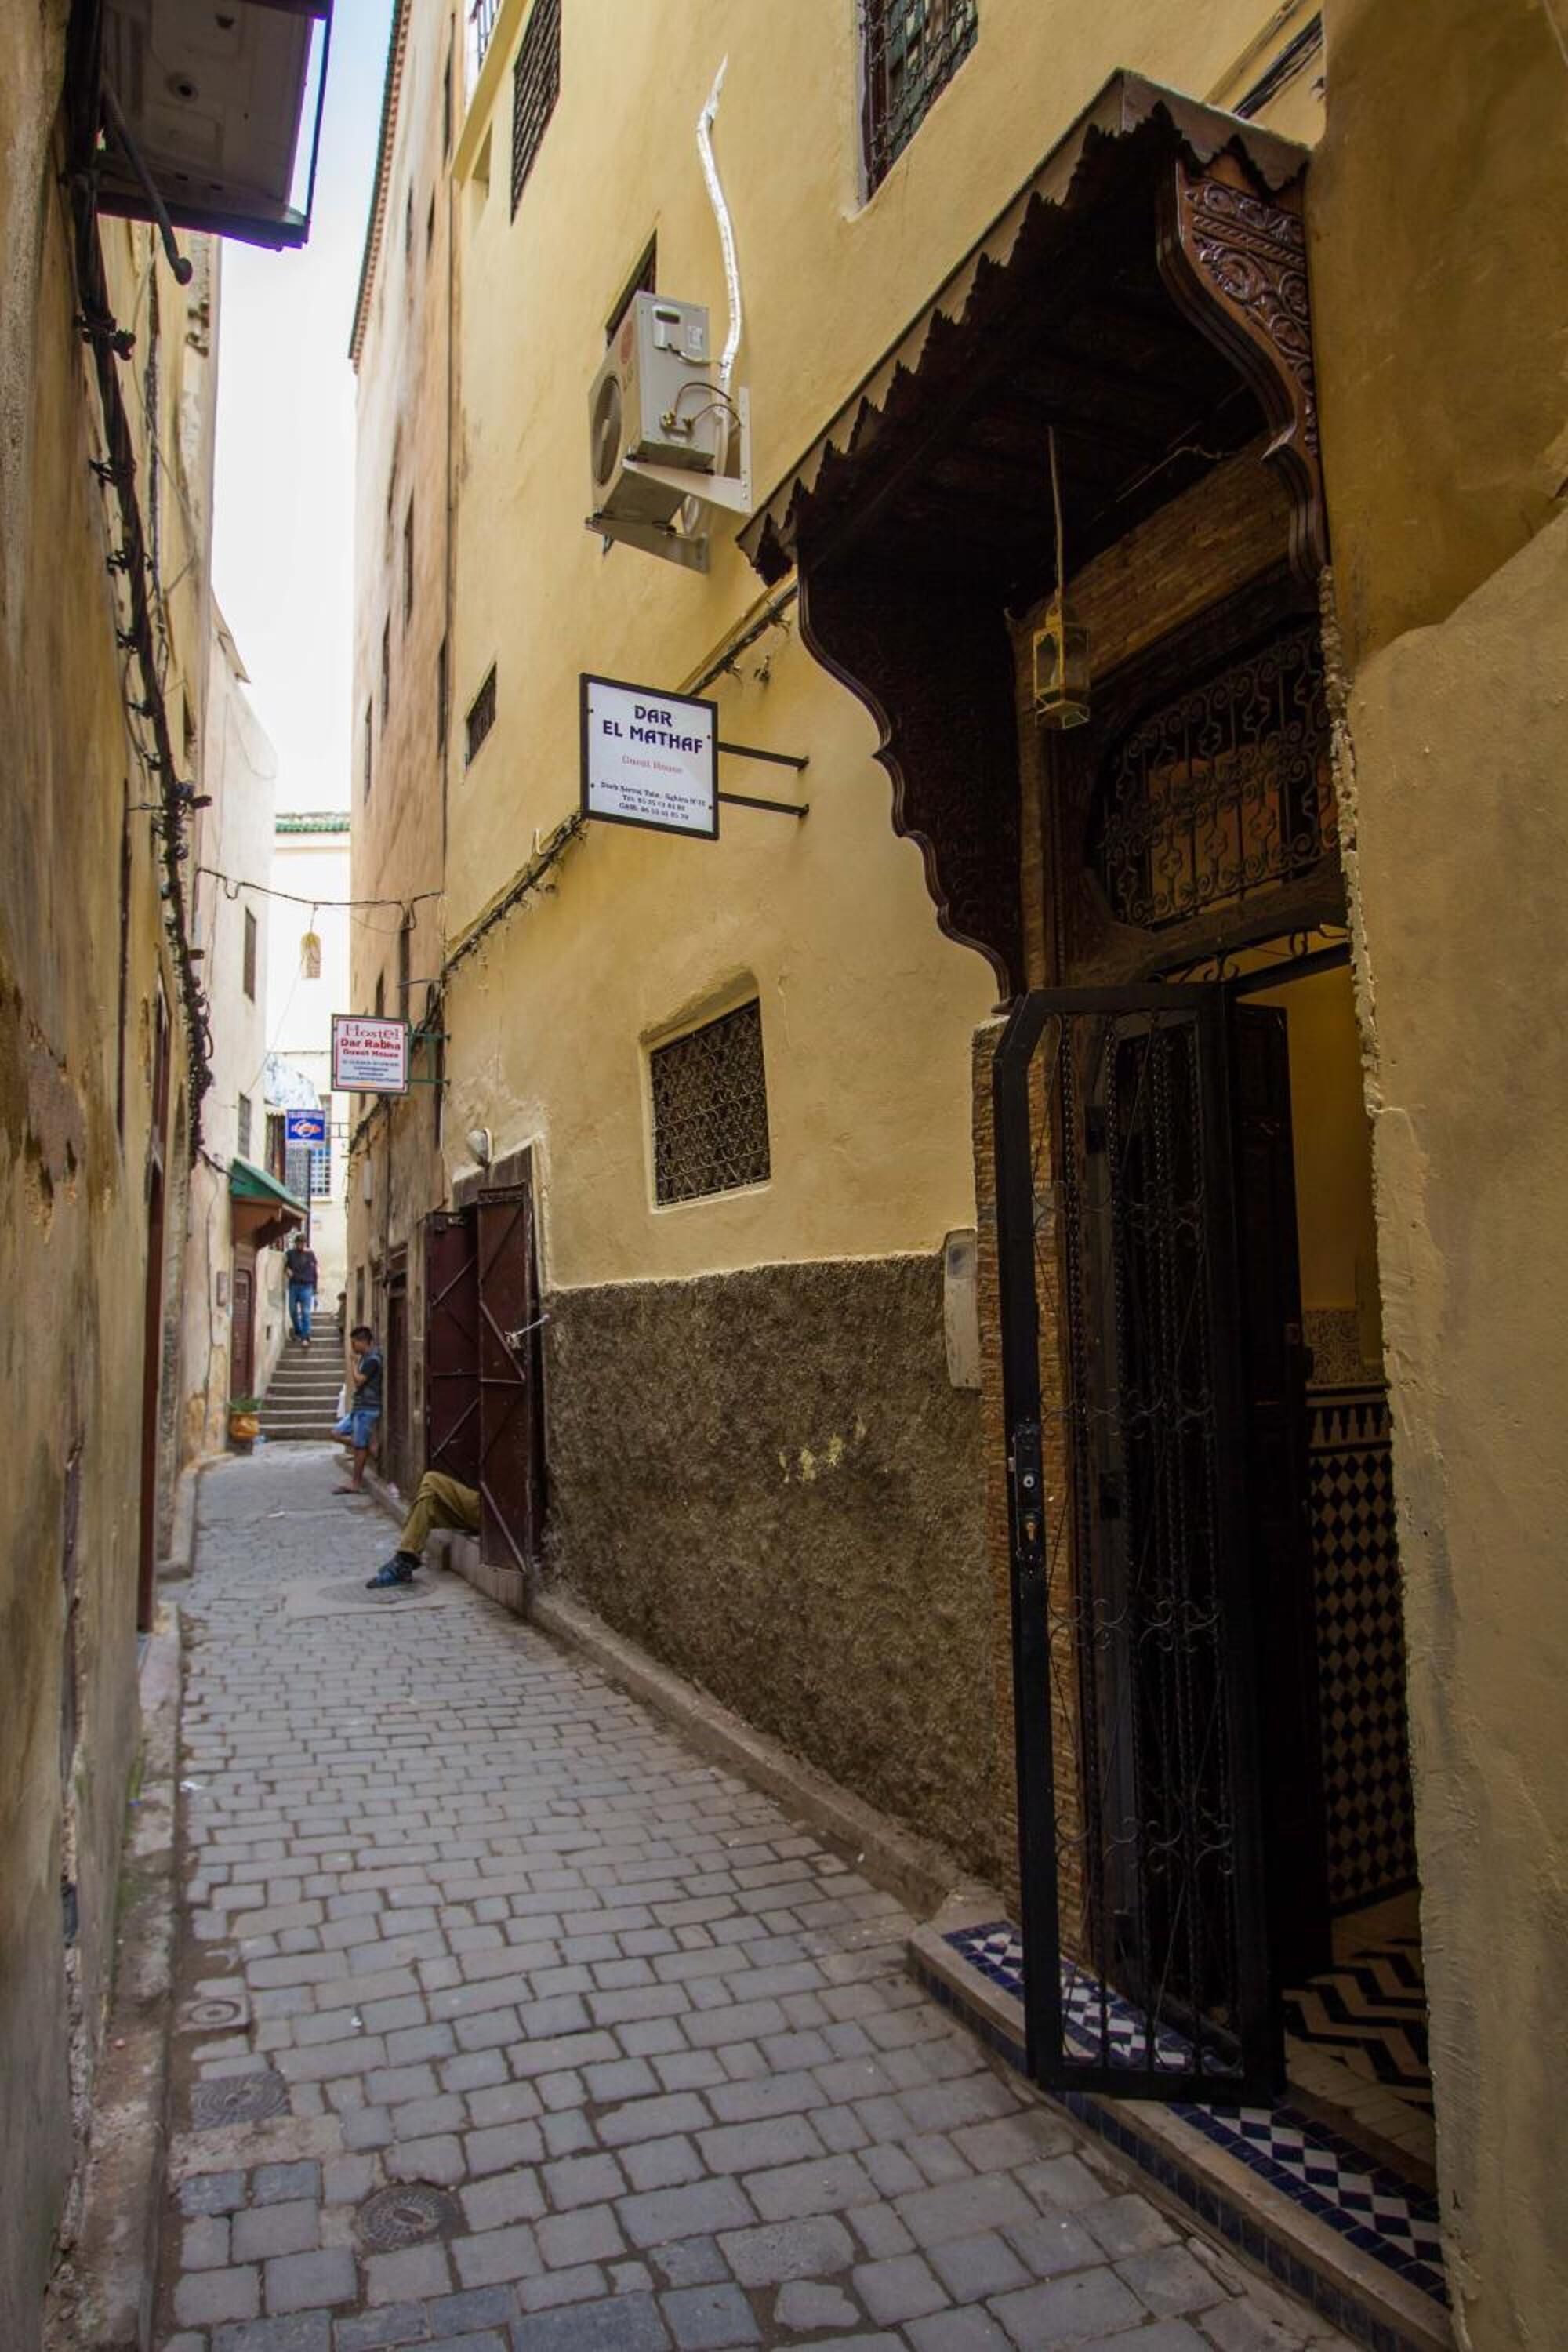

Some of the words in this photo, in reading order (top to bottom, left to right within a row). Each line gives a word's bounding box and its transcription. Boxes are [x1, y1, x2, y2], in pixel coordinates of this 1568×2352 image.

[634, 705, 673, 727] DAR
[603, 720, 623, 737] EL
[630, 725, 703, 753] MATHAF
[346, 1024, 399, 1040] Hostel
[340, 1037, 361, 1047] Dar
[364, 1040, 401, 1051] Rabha
